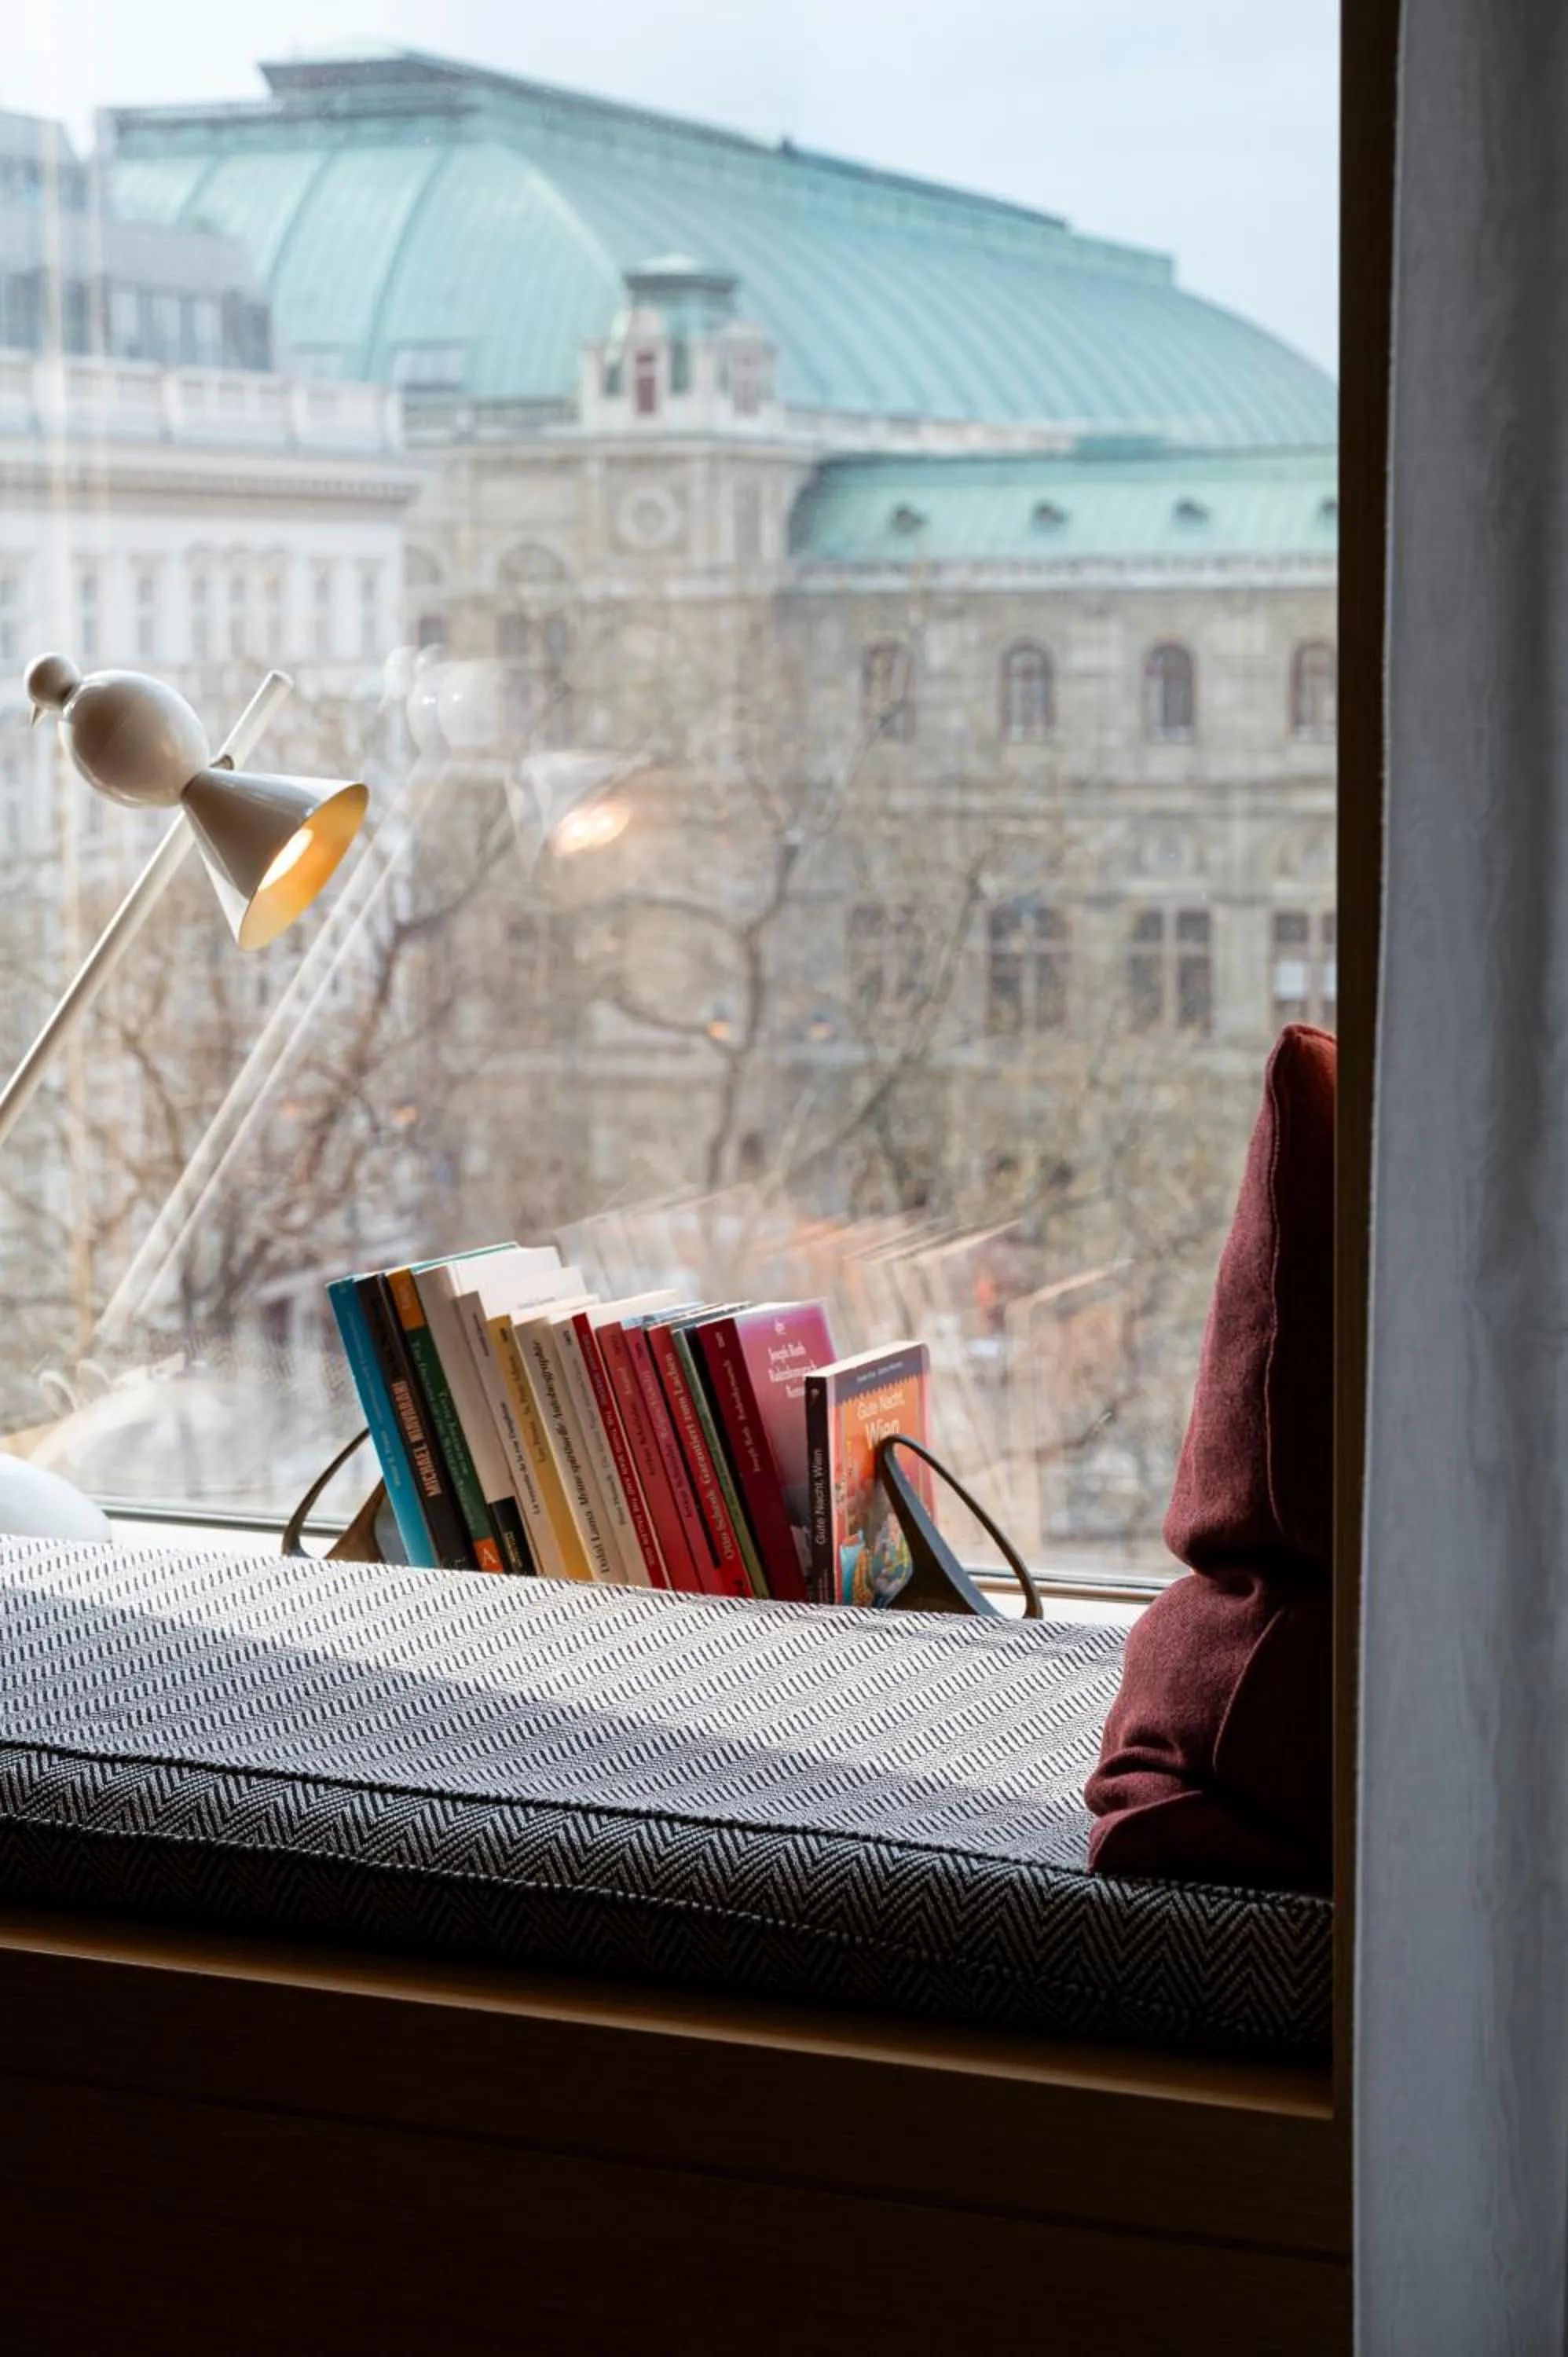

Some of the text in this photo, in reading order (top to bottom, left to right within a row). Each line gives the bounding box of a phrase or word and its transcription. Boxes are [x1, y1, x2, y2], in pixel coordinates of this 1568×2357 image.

[662, 1351, 684, 1395] Lachen
[856, 1401, 877, 1421] Gute
[865, 1417, 901, 1450] Wien
[684, 1421, 713, 1485] Garantiert
[811, 1448, 822, 1478] Wien
[412, 1443, 441, 1497] MICHAEL
[583, 1509, 600, 1542] Lama
[815, 1517, 825, 1545] Gute
[480, 1546, 499, 1567] A
[592, 1542, 611, 1574] Dalai
[718, 1530, 735, 1560] Otto
